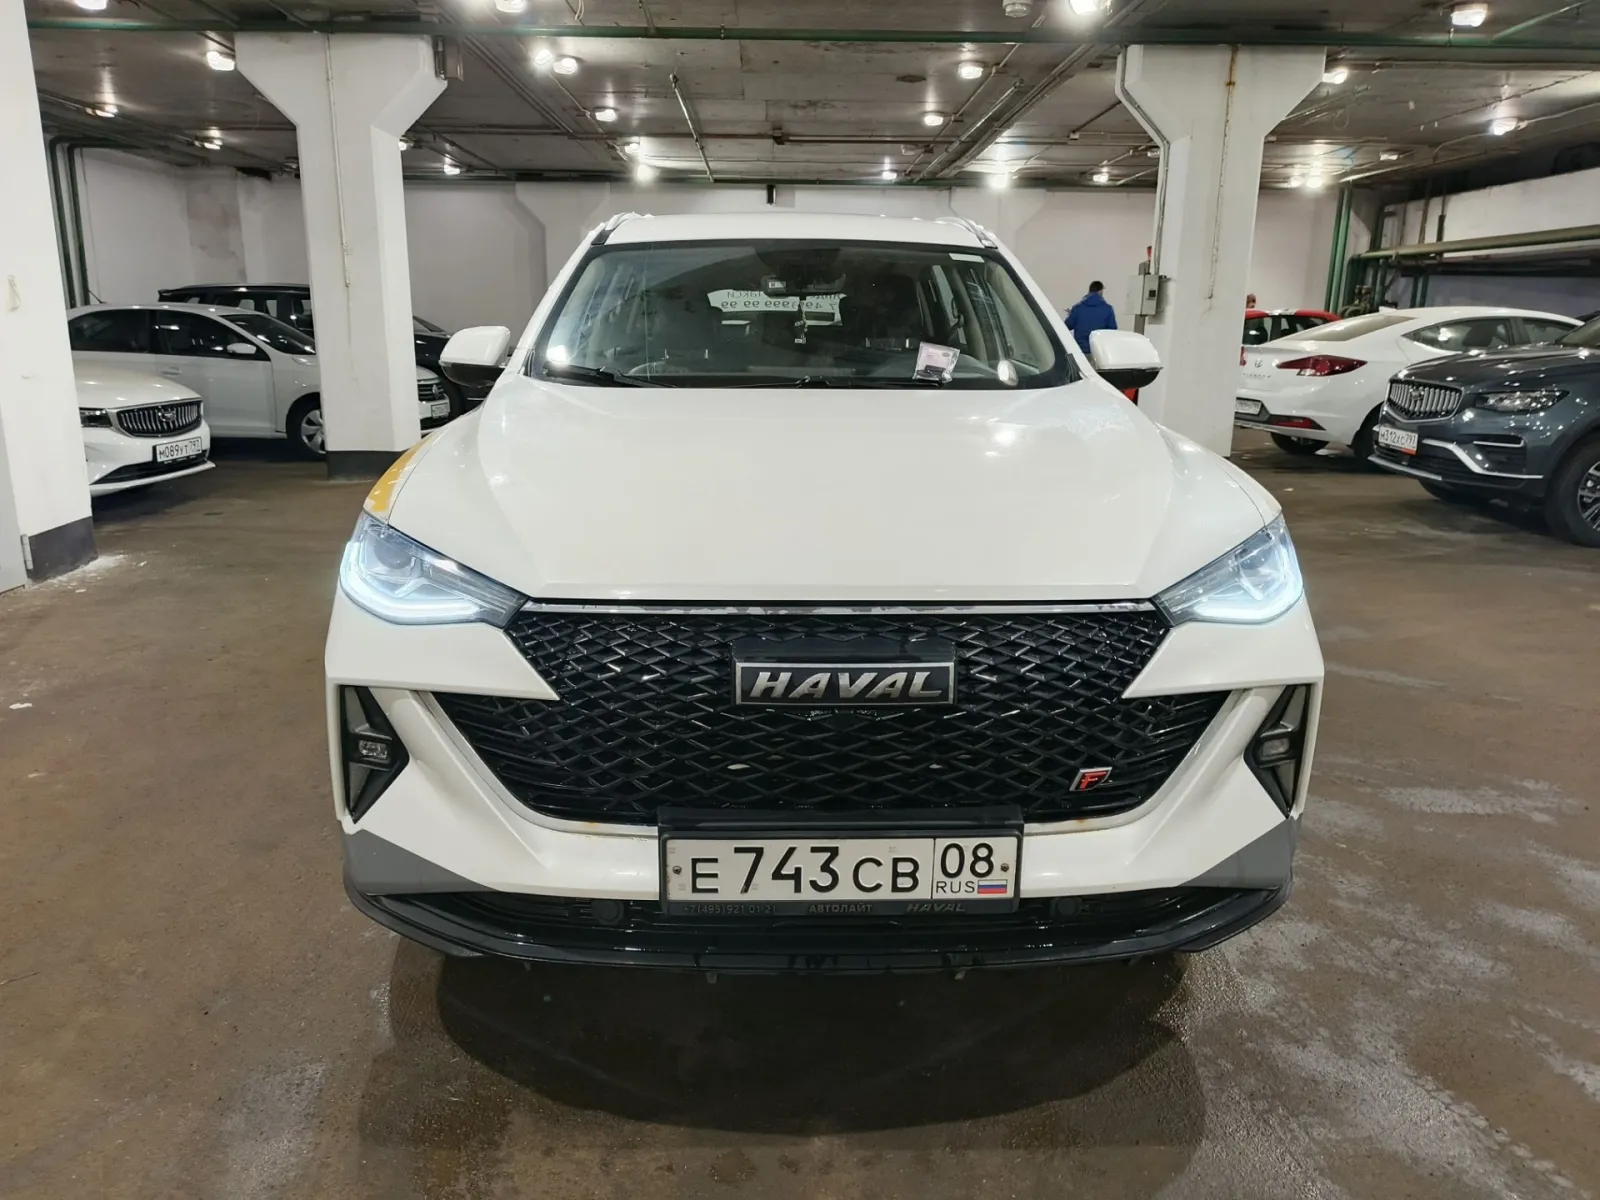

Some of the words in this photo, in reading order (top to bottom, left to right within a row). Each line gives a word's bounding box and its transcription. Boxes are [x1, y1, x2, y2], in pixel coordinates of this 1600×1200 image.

[750, 671, 942, 699] HAVAL
[939, 842, 995, 879] 08
[935, 880, 975, 894] RUS
[809, 902, 873, 913] АВТОЛАЙТ
[906, 903, 967, 913] HAVAL
